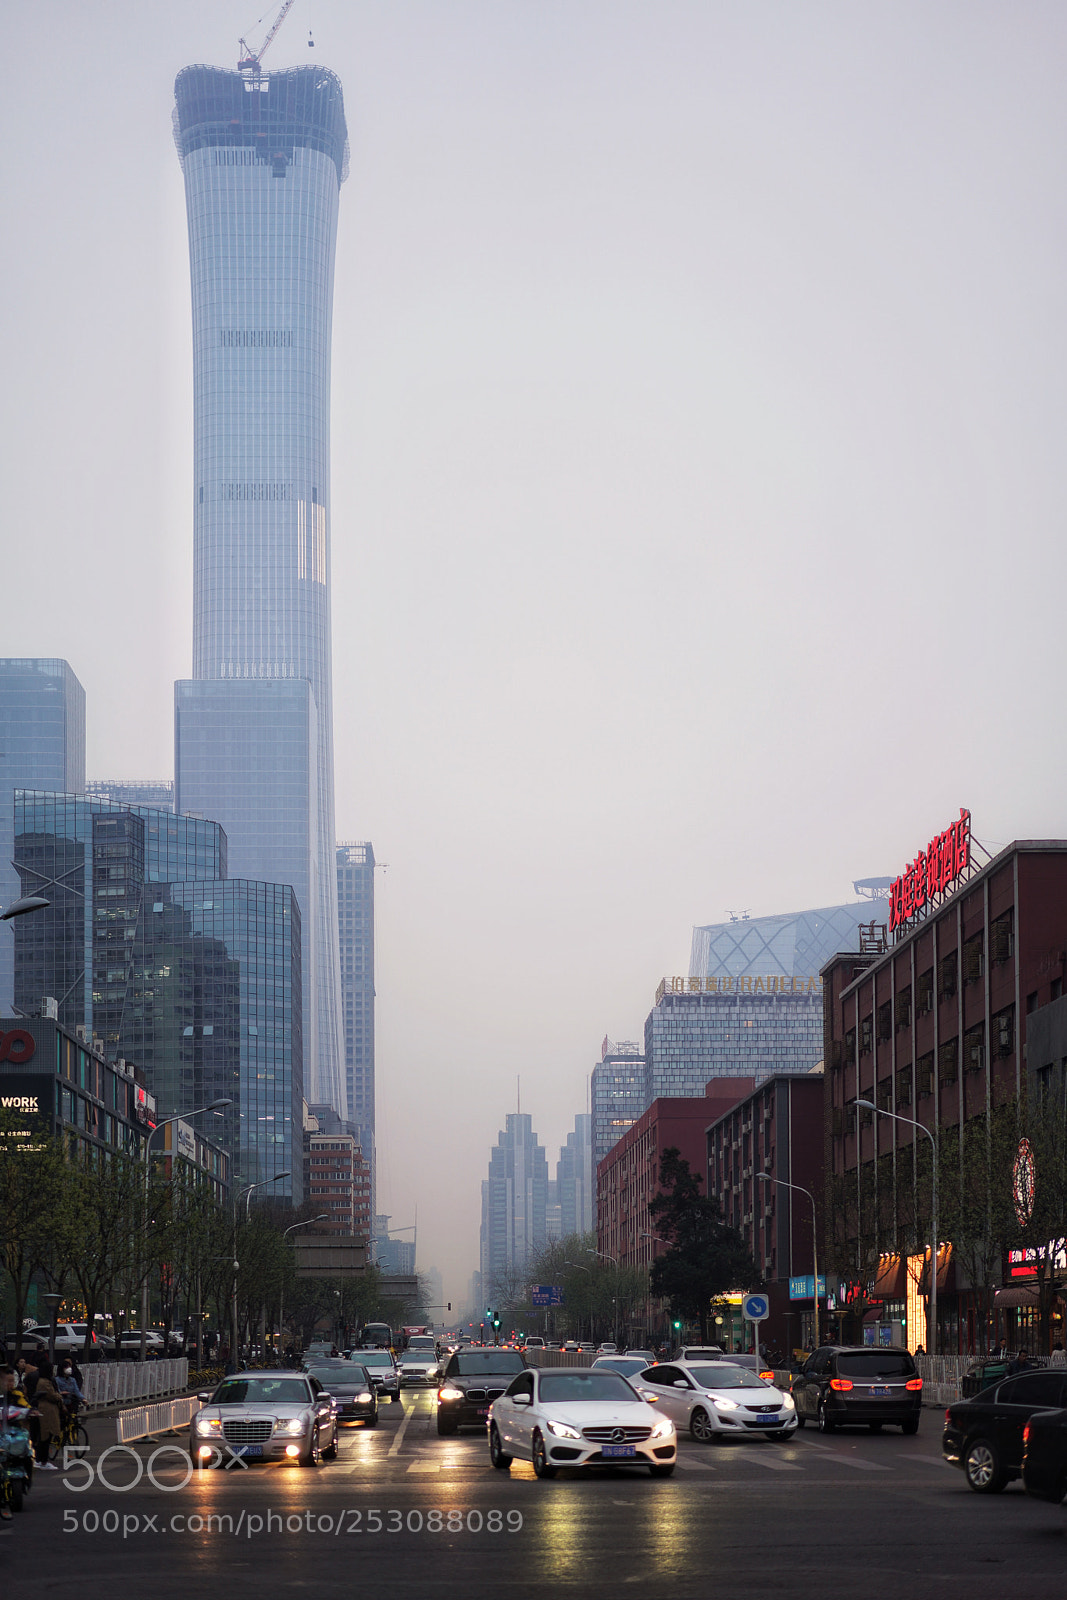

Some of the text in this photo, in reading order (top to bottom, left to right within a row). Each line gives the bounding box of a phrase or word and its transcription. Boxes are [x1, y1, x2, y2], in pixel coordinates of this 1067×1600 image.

[889, 808, 969, 932] 汉庭连锁酒店
[1, 1097, 39, 1108] WORK
